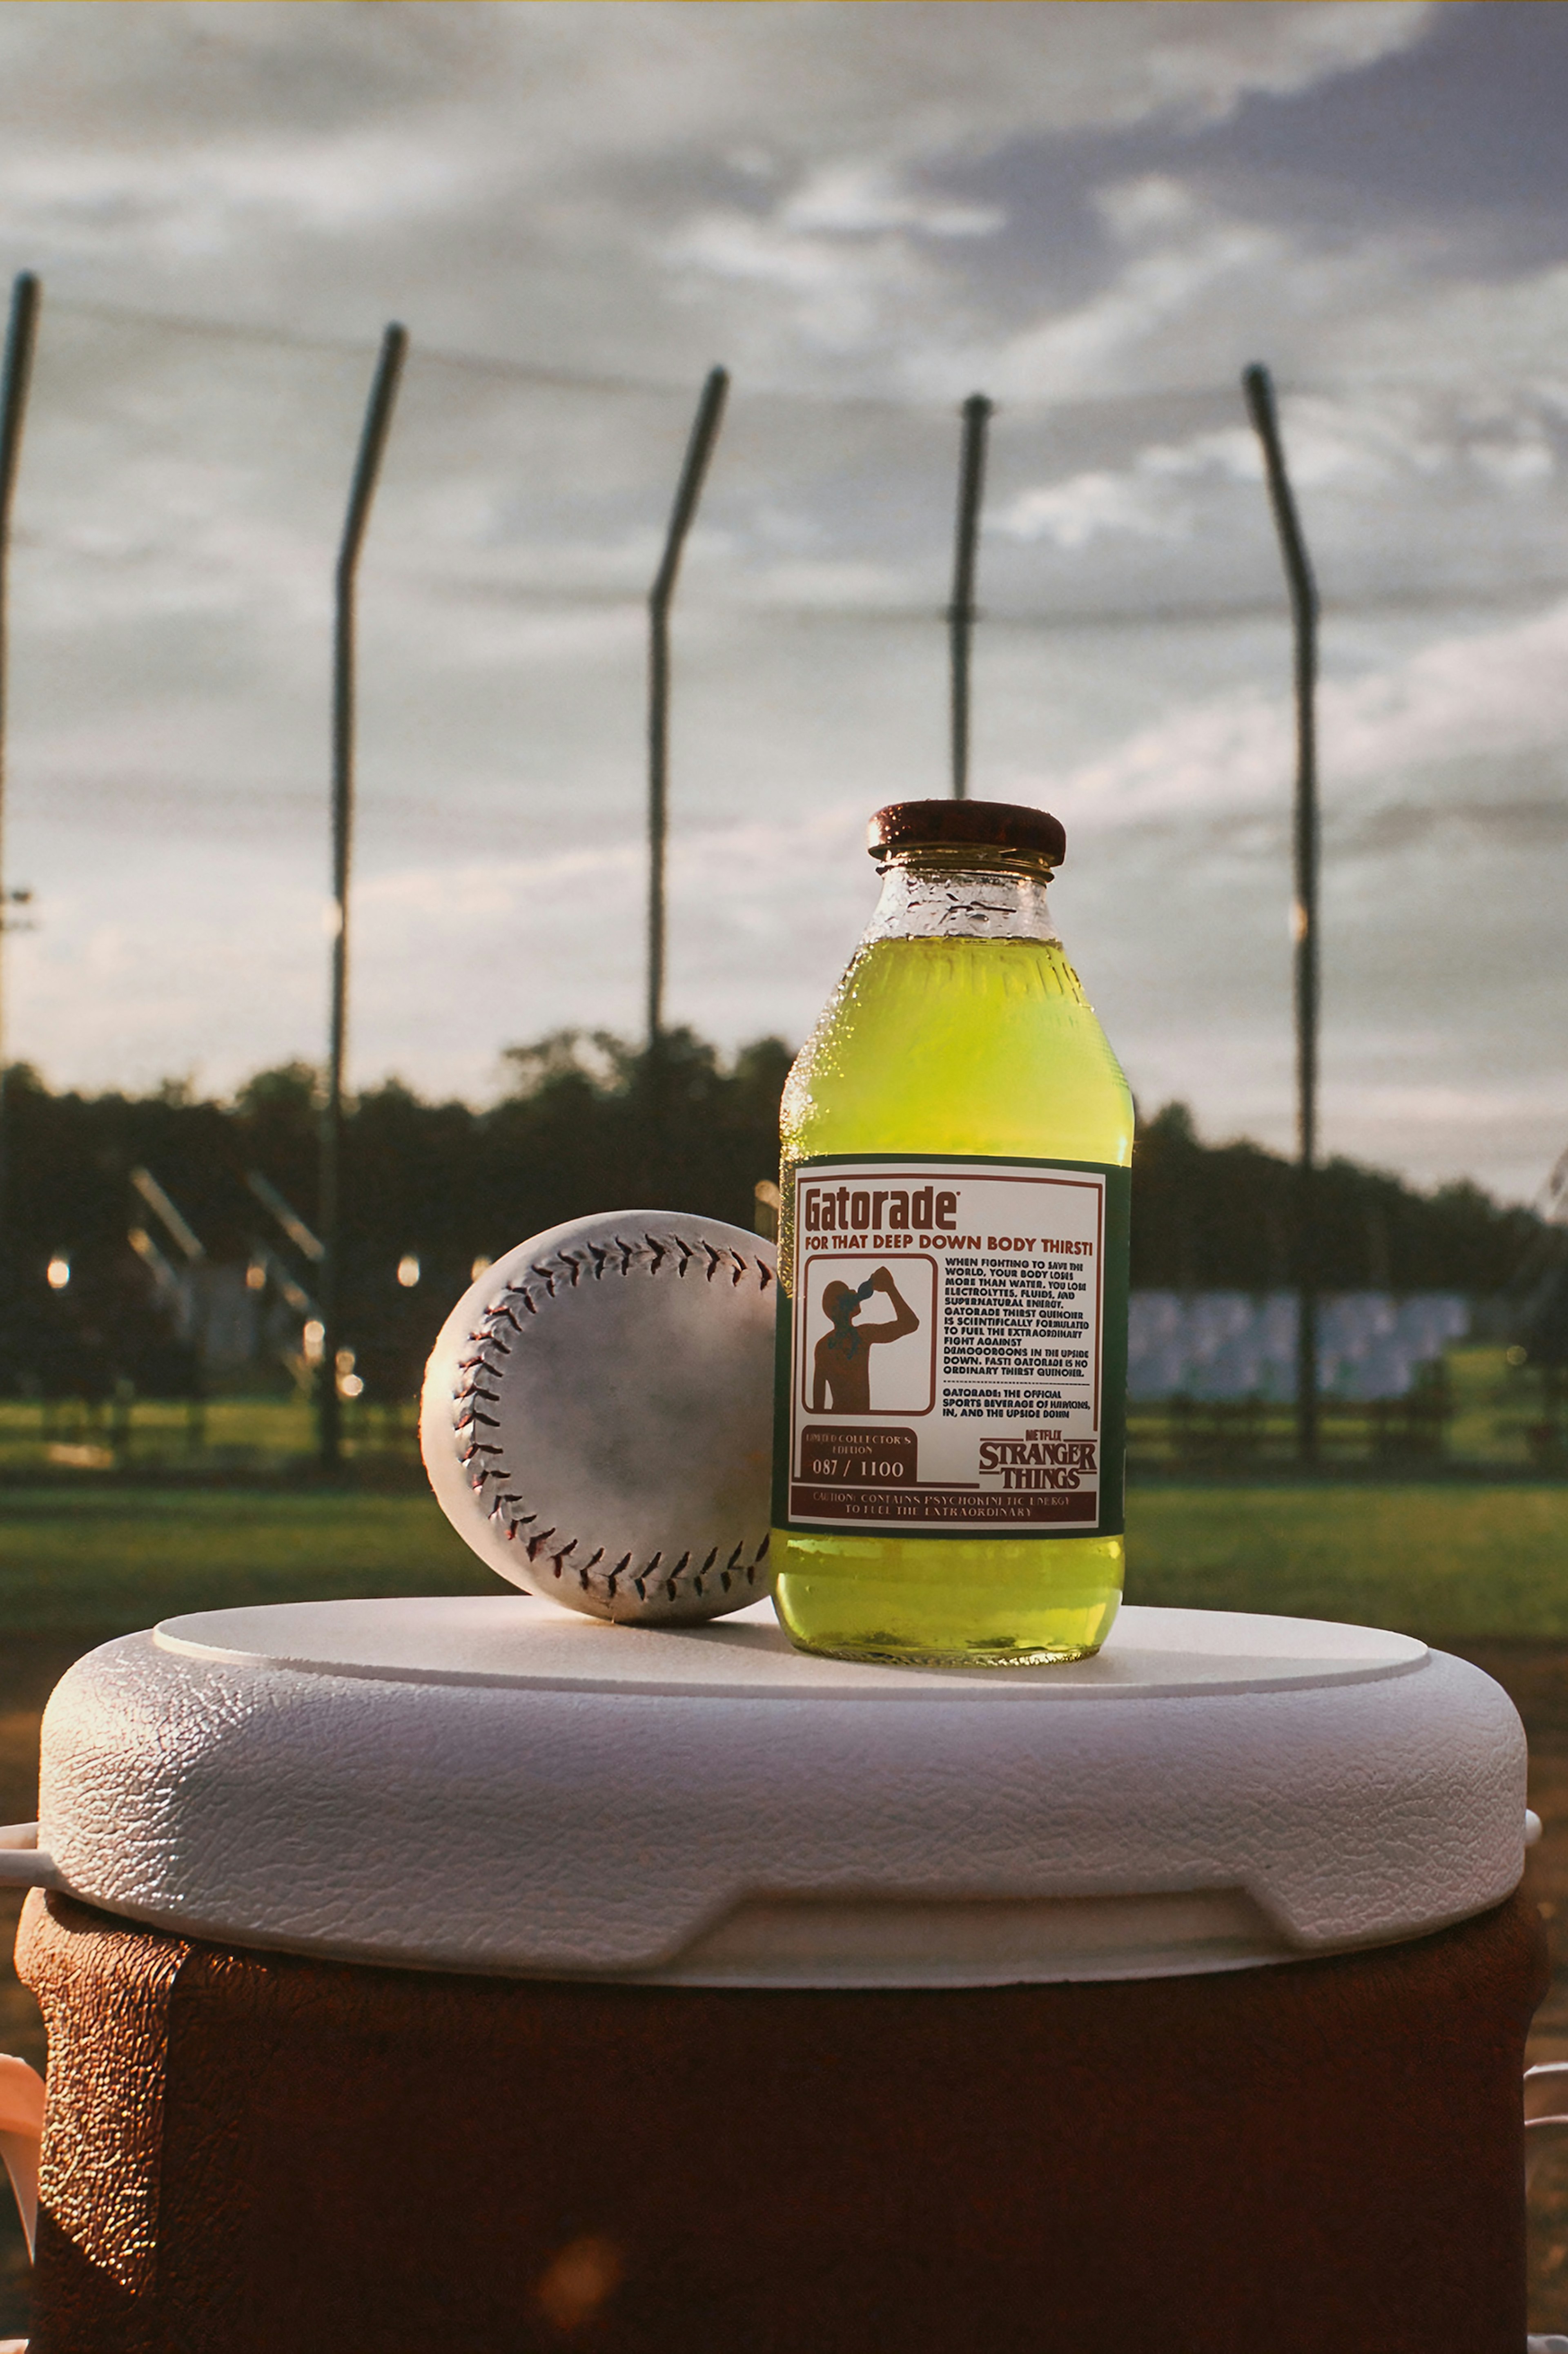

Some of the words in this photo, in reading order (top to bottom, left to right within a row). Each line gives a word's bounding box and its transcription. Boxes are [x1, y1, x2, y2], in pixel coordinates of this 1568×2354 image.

[805, 1186, 957, 1231] Gatorade
[805, 1236, 829, 1251] FOR
[832, 1235, 868, 1249] THAT
[874, 1235, 913, 1249] DEEP
[920, 1235, 980, 1250] DOWN
[988, 1236, 1036, 1253] BODY
[1041, 1238, 1094, 1256] THIRST!
[945, 1258, 978, 1266] WHEN
[982, 1259, 1029, 1268] FIGHTING
[1032, 1261, 1045, 1269] TO
[1069, 1262, 1083, 1271] THE
[945, 1268, 986, 1277] WORLD,
[990, 1269, 1017, 1277] YOUR
[1021, 1270, 1048, 1278] BODY
[1050, 1271, 1073, 1280] LOSES
[979, 1279, 1006, 1287] THAN
[1049, 1281, 1066, 1290] YOU
[1068, 1282, 1086, 1291] LOSE
[945, 1297, 1023, 1307] SUPERNATURAL
[945, 1307, 1000, 1316] GATORADE
[1003, 1309, 1036, 1317] THIRST
[957, 1317, 1032, 1327] SCIENTIFICALLY
[961, 1327, 984, 1335] FUEL
[987, 1328, 1004, 1336] THE
[1008, 1329, 1082, 1338] EXTRAORDINARY
[944, 1337, 974, 1345] FIGHT
[977, 1338, 1022, 1346] AGAINST
[1031, 1348, 1041, 1356] IN
[1061, 1349, 1089, 1358] UPSIDE
[985, 1357, 1011, 1365] FAST!
[1014, 1358, 1062, 1367] GATORADE
[944, 1366, 998, 1375] ORDINARY
[1001, 1367, 1034, 1376] THIRST
[1004, 1390, 1020, 1398] THE
[1023, 1390, 1061, 1399] OFFICIAL
[942, 1399, 981, 1407] SPORTS
[984, 1400, 1033, 1408] BEVERAGE
[1036, 1400, 1048, 1408] OF
[942, 1409, 957, 1417] IN,
[960, 1409, 983, 1417] AND
[987, 1409, 1003, 1418] THE
[1007, 1409, 1040, 1418] UPSIDE
[1043, 1410, 1069, 1418] DOWN
[839, 1434, 911, 1444] COLLECTOR'S
[1025, 1429, 1062, 1441] NETFLIX
[833, 1446, 872, 1454] EDITION
[979, 1442, 1097, 1470] STRANGER
[813, 1459, 837, 1475] 087
[862, 1461, 904, 1477] 1100
[1000, 1468, 1080, 1489] THINGS
[861, 1494, 920, 1504] CONTAINS
[924, 1496, 1025, 1506] PSYCHOKINETIC
[1030, 1496, 1069, 1506] ENERGY
[846, 1505, 860, 1513] TO
[864, 1505, 890, 1515] FUEL
[897, 1506, 918, 1515] THE
[924, 1507, 1031, 1517] EXTRAORDINARY
